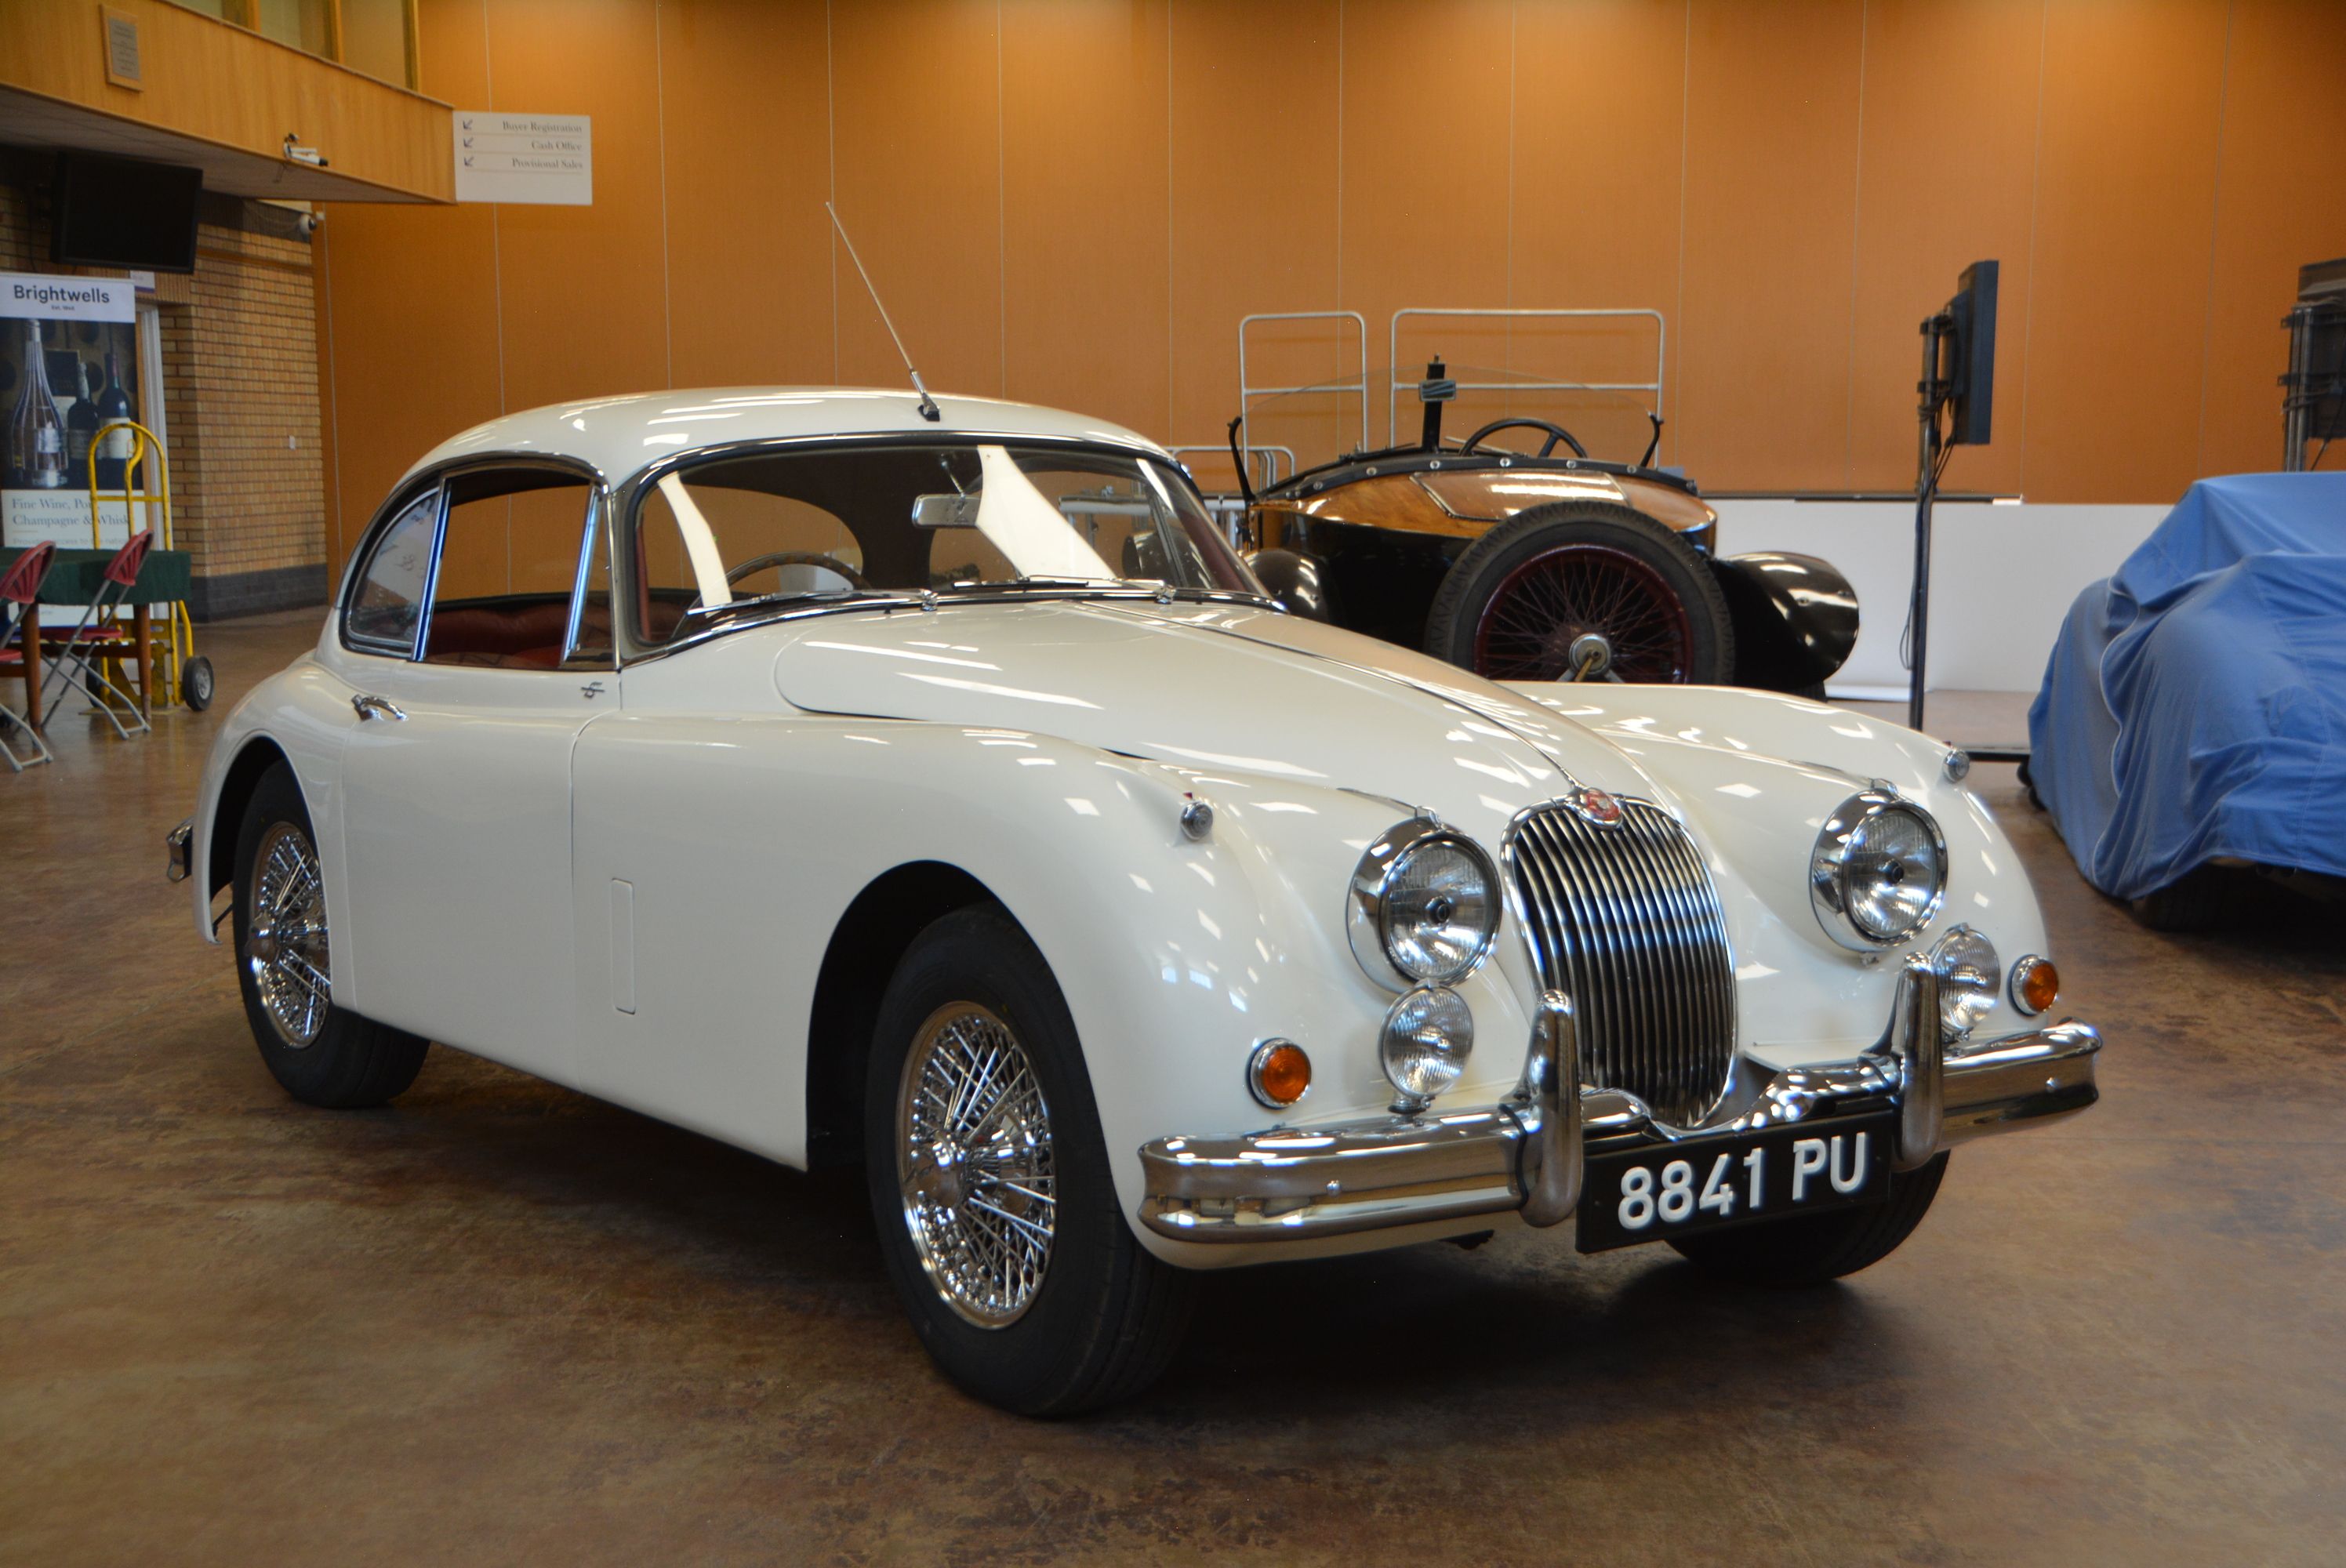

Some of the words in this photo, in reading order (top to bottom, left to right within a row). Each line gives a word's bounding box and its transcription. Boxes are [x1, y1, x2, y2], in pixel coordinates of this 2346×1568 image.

[503, 121, 528, 131] Buyer
[531, 122, 582, 132] Registration
[532, 140, 553, 150] Cash
[556, 140, 583, 151] Office
[512, 158, 558, 169] Provisional
[561, 159, 583, 169] Sales
[13, 285, 110, 303] Brightwells
[13, 498, 37, 510] Fine
[40, 499, 71, 510] Wine,
[13, 514, 78, 528] Champagne
[83, 515, 93, 525] &
[97, 514, 129, 525] Whisk
[1618, 1147, 1764, 1230] 8841
[1792, 1131, 1867, 1201] PU
